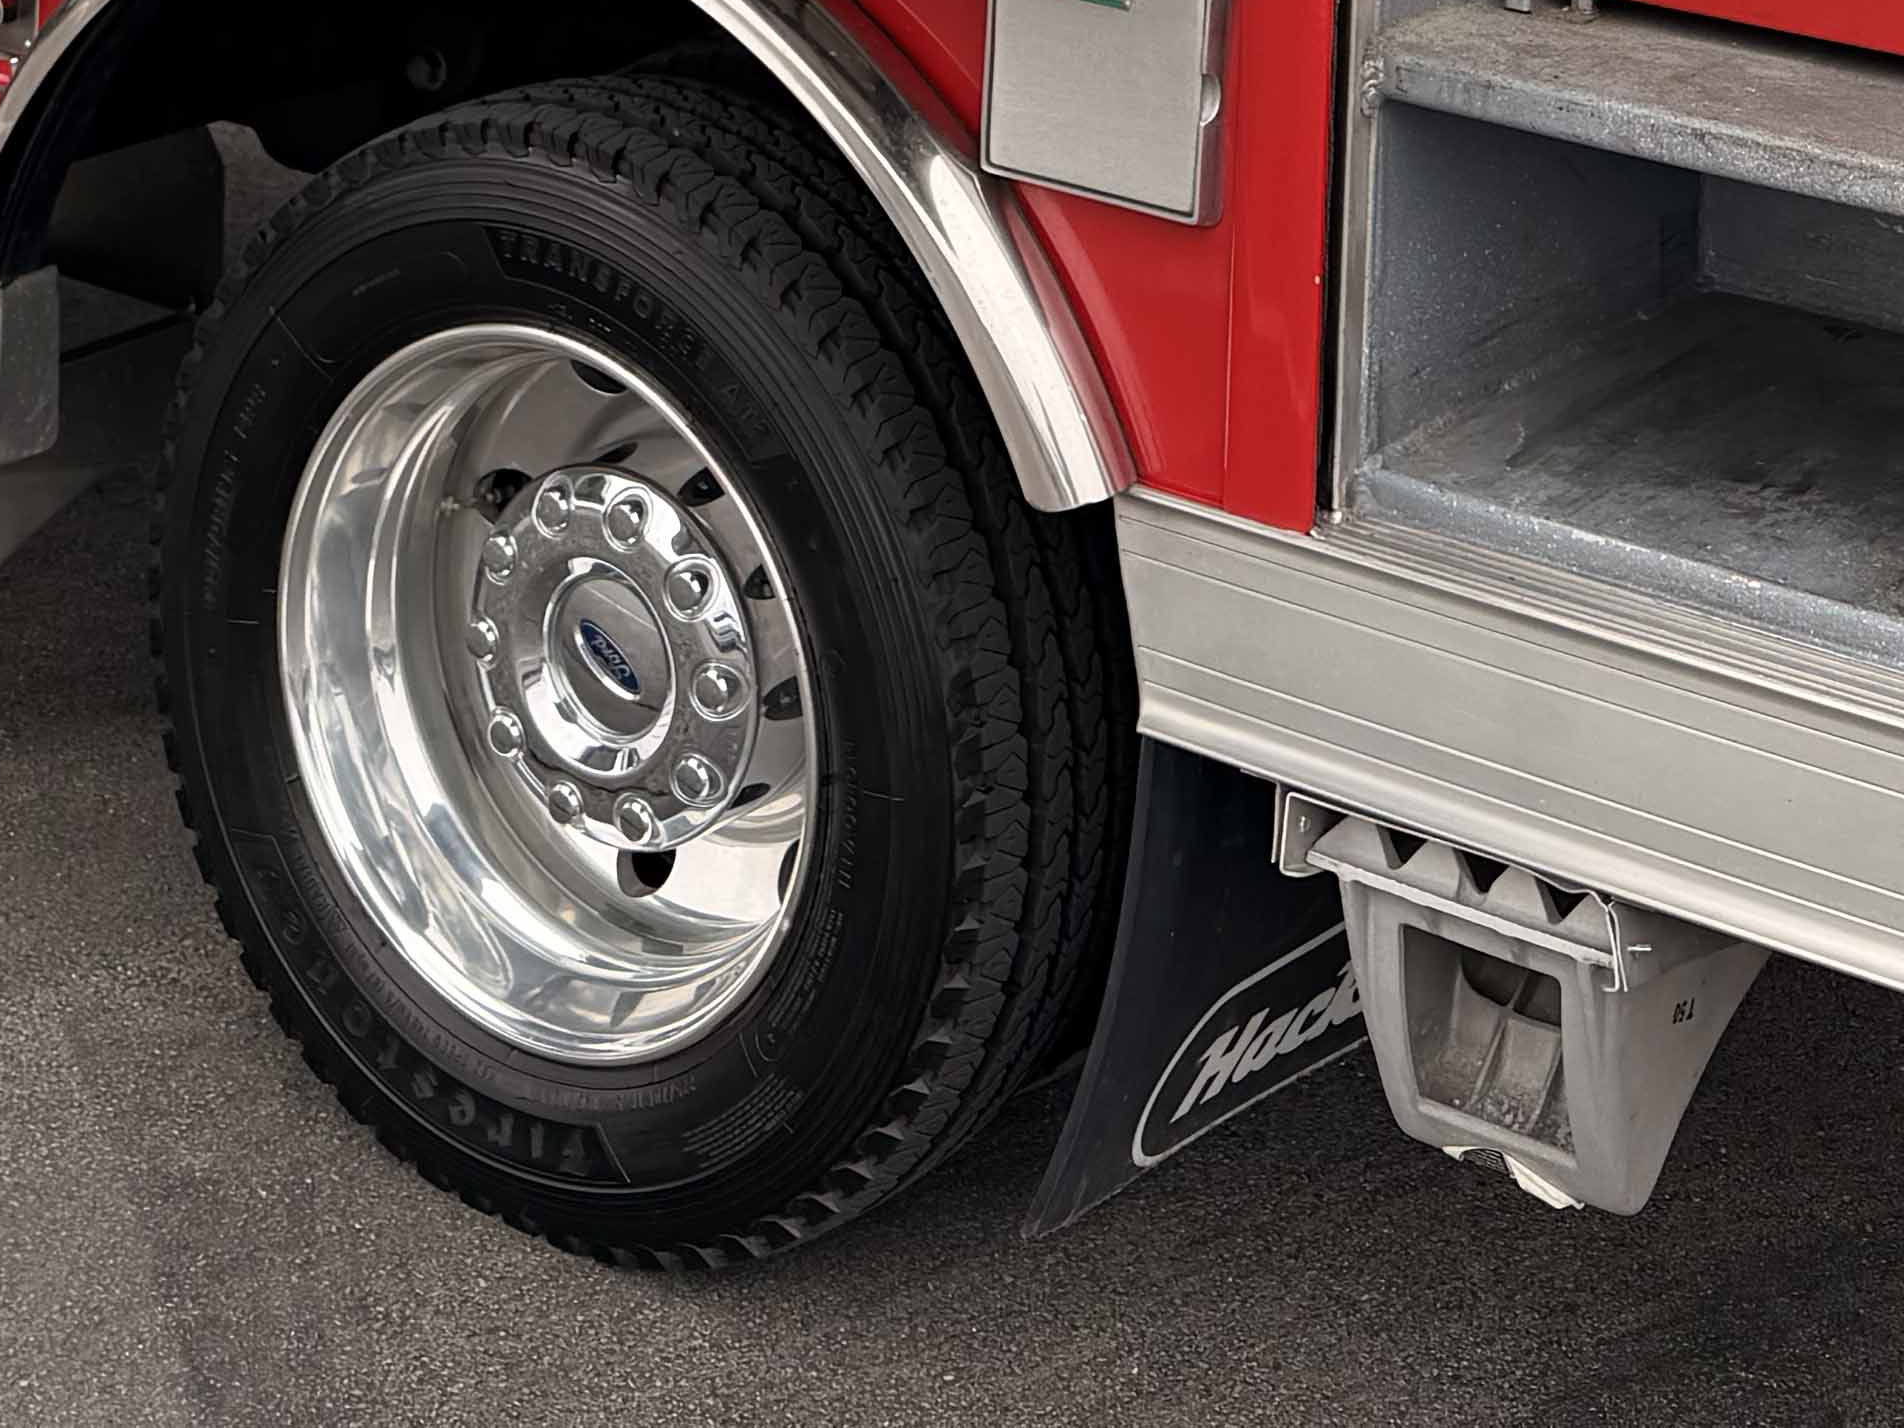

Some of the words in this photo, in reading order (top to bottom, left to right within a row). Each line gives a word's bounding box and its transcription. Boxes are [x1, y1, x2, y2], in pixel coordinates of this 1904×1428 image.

[590, 634, 631, 680] Ford
[281, 907, 594, 1177] Firestone
[1169, 959, 1364, 1125] Hack
